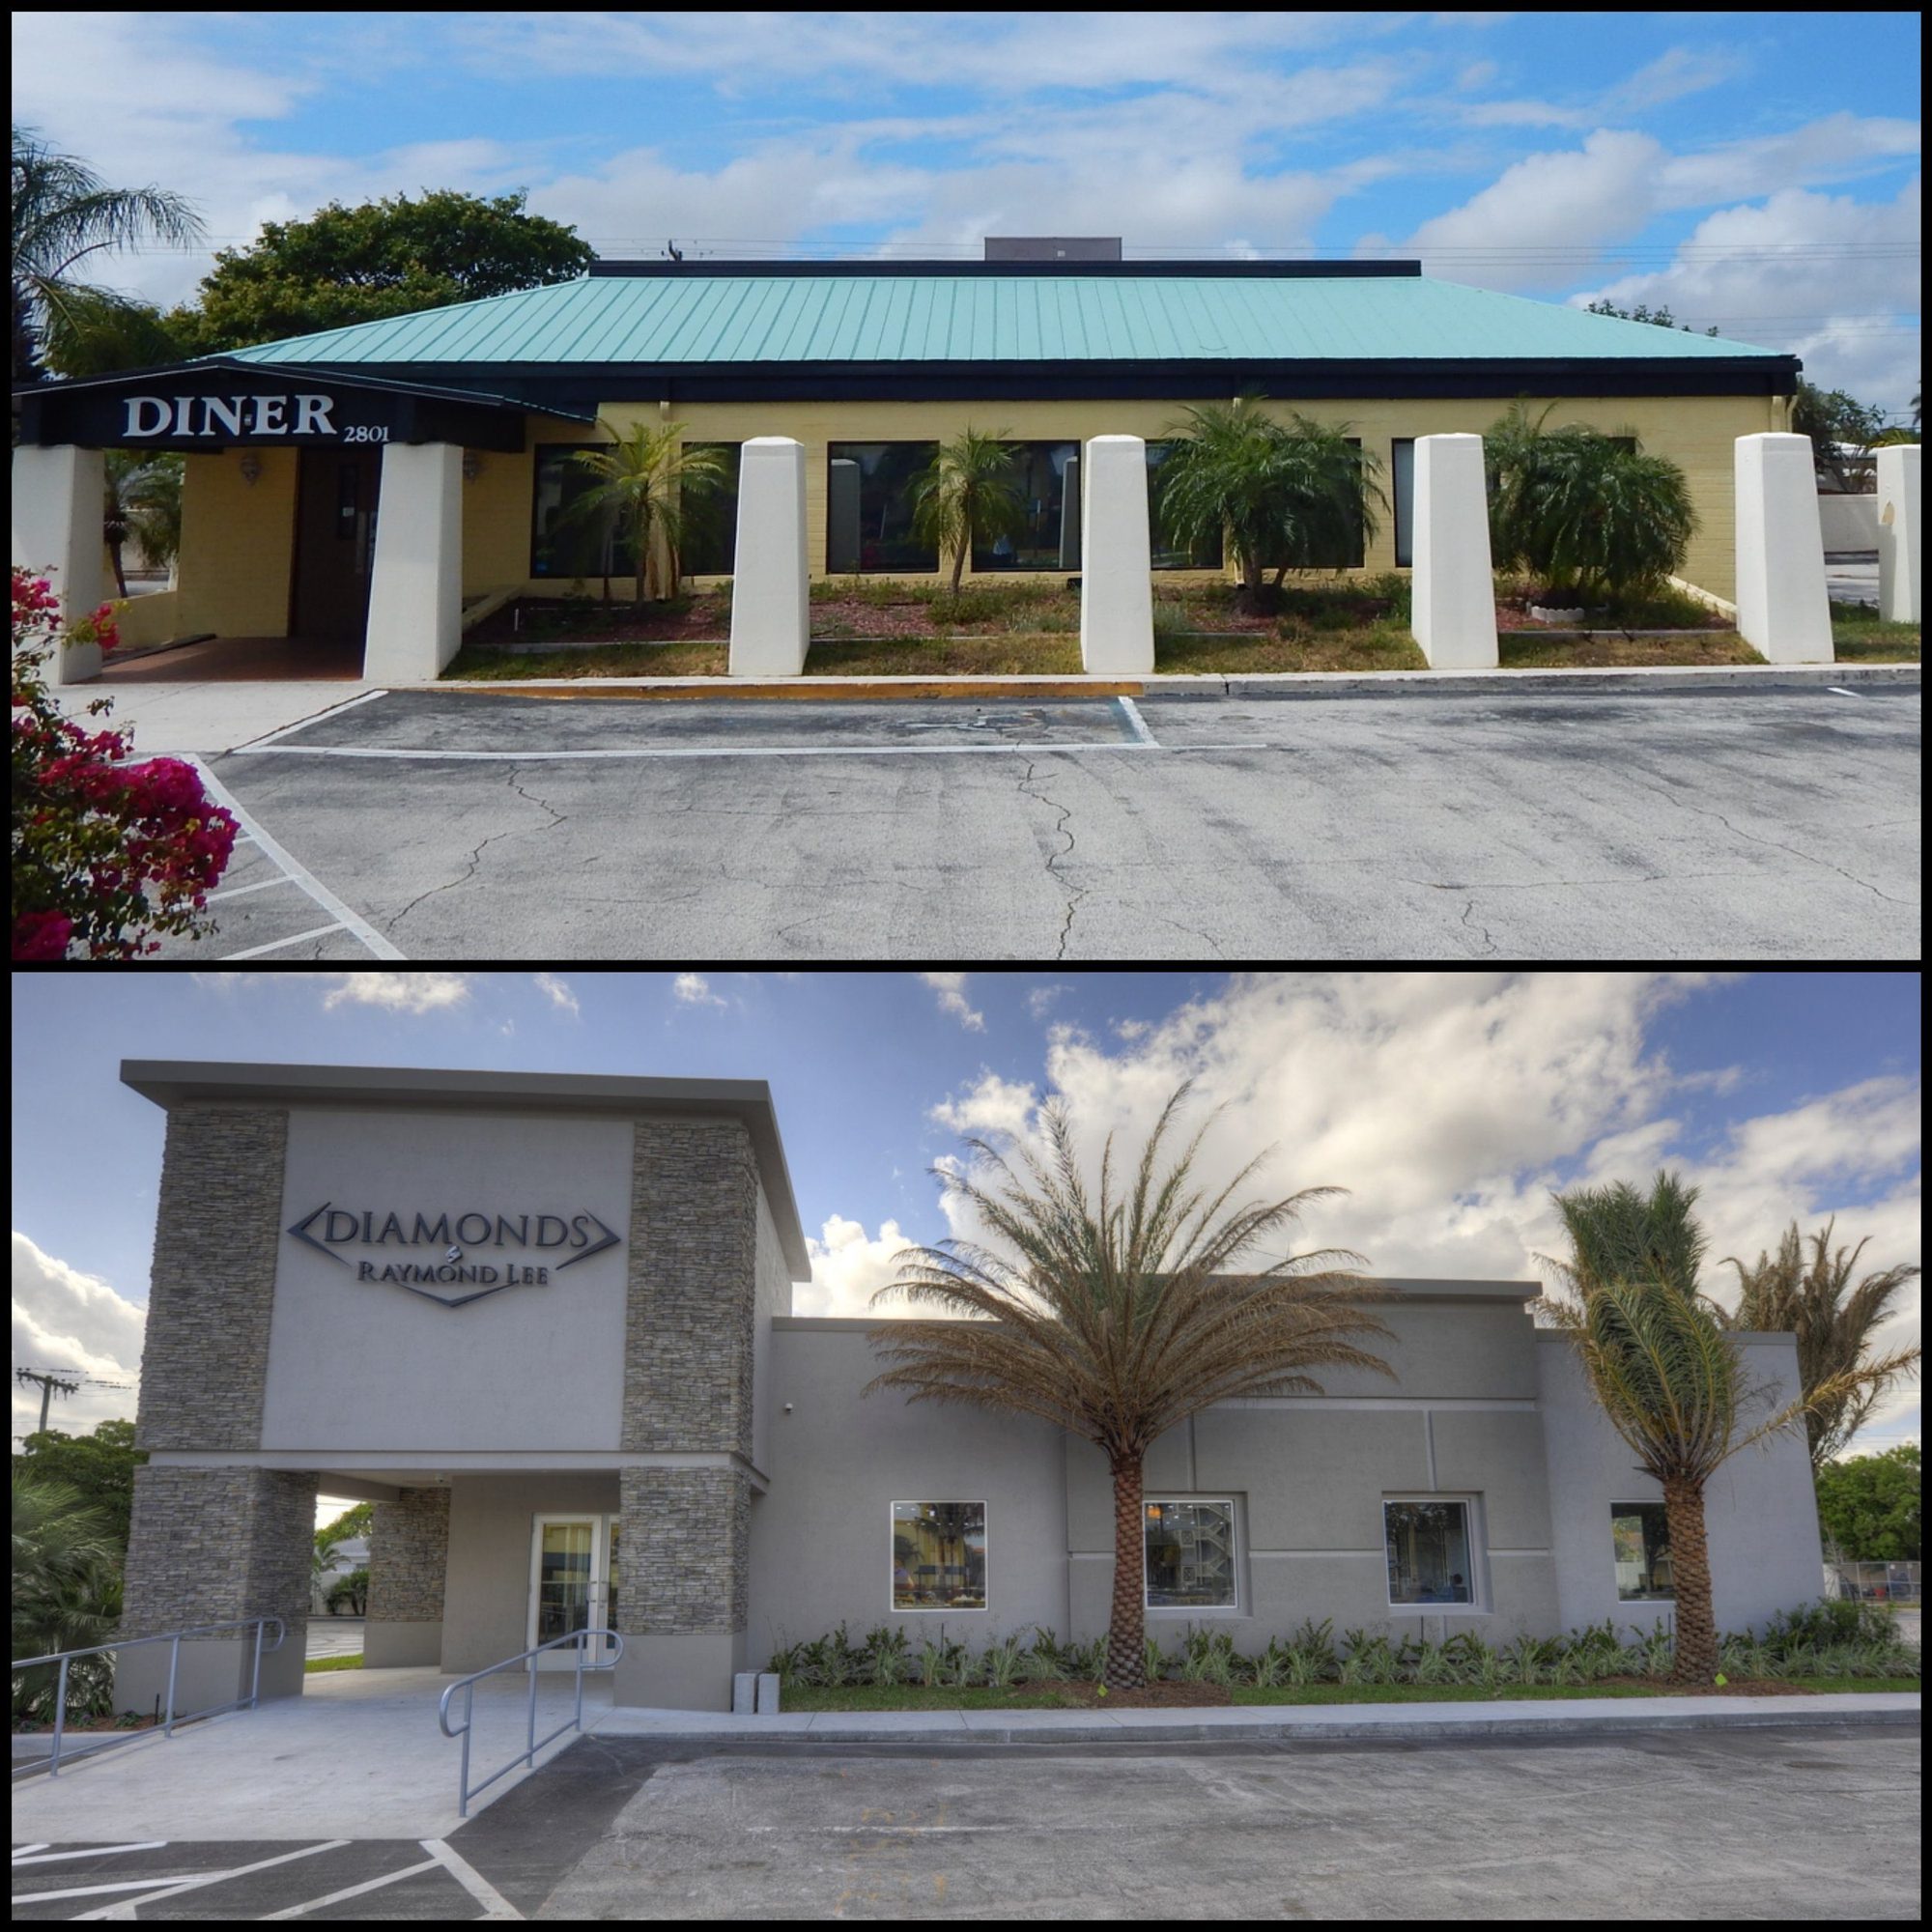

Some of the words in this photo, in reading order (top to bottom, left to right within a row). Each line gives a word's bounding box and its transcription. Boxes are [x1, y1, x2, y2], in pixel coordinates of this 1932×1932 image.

[123, 395, 337, 437] DINER
[344, 426, 389, 442] 2801
[325, 1210, 589, 1247] DIAMONDS
[357, 1261, 498, 1284] RAYMOND
[507, 1264, 549, 1286] LEE
